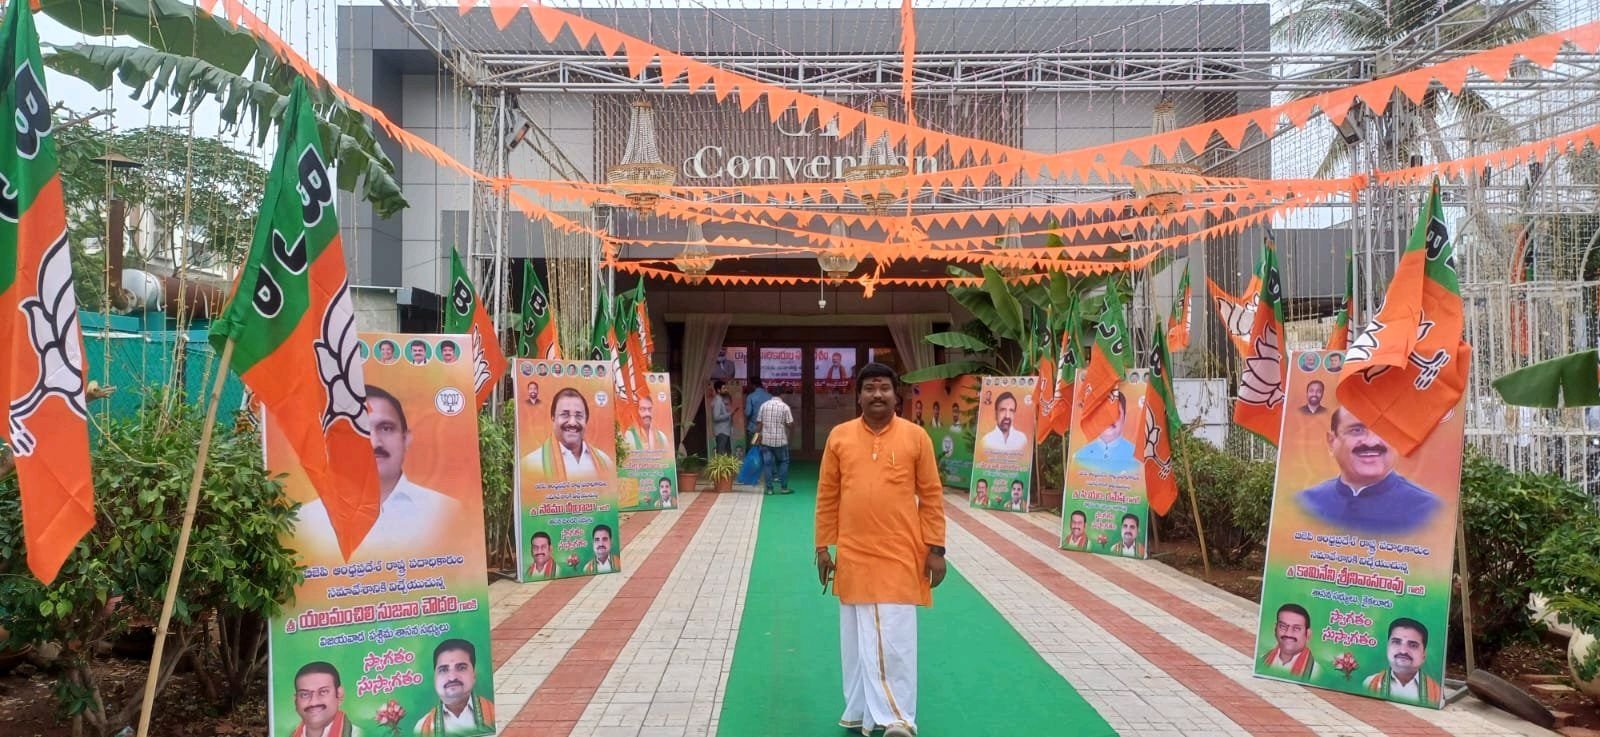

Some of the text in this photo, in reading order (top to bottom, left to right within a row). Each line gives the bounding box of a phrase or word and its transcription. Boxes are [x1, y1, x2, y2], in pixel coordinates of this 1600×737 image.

[683, 146, 938, 180] Convenn
[250, 143, 333, 318] BJP
[1296, 564, 1336, 581] కామినేని
[1337, 567, 1404, 595] శ్రీనివాసరావు
[299, 608, 375, 629] యలమంచిలి
[377, 602, 419, 619] సుజనా
[422, 596, 458, 615] చౌదరి
[1330, 609, 1372, 626] స్వాగతం
[1322, 626, 1377, 646] సుస్వాగతం
[363, 648, 414, 671] స్వాగతం
[357, 670, 422, 696] సుస్వాగతం
